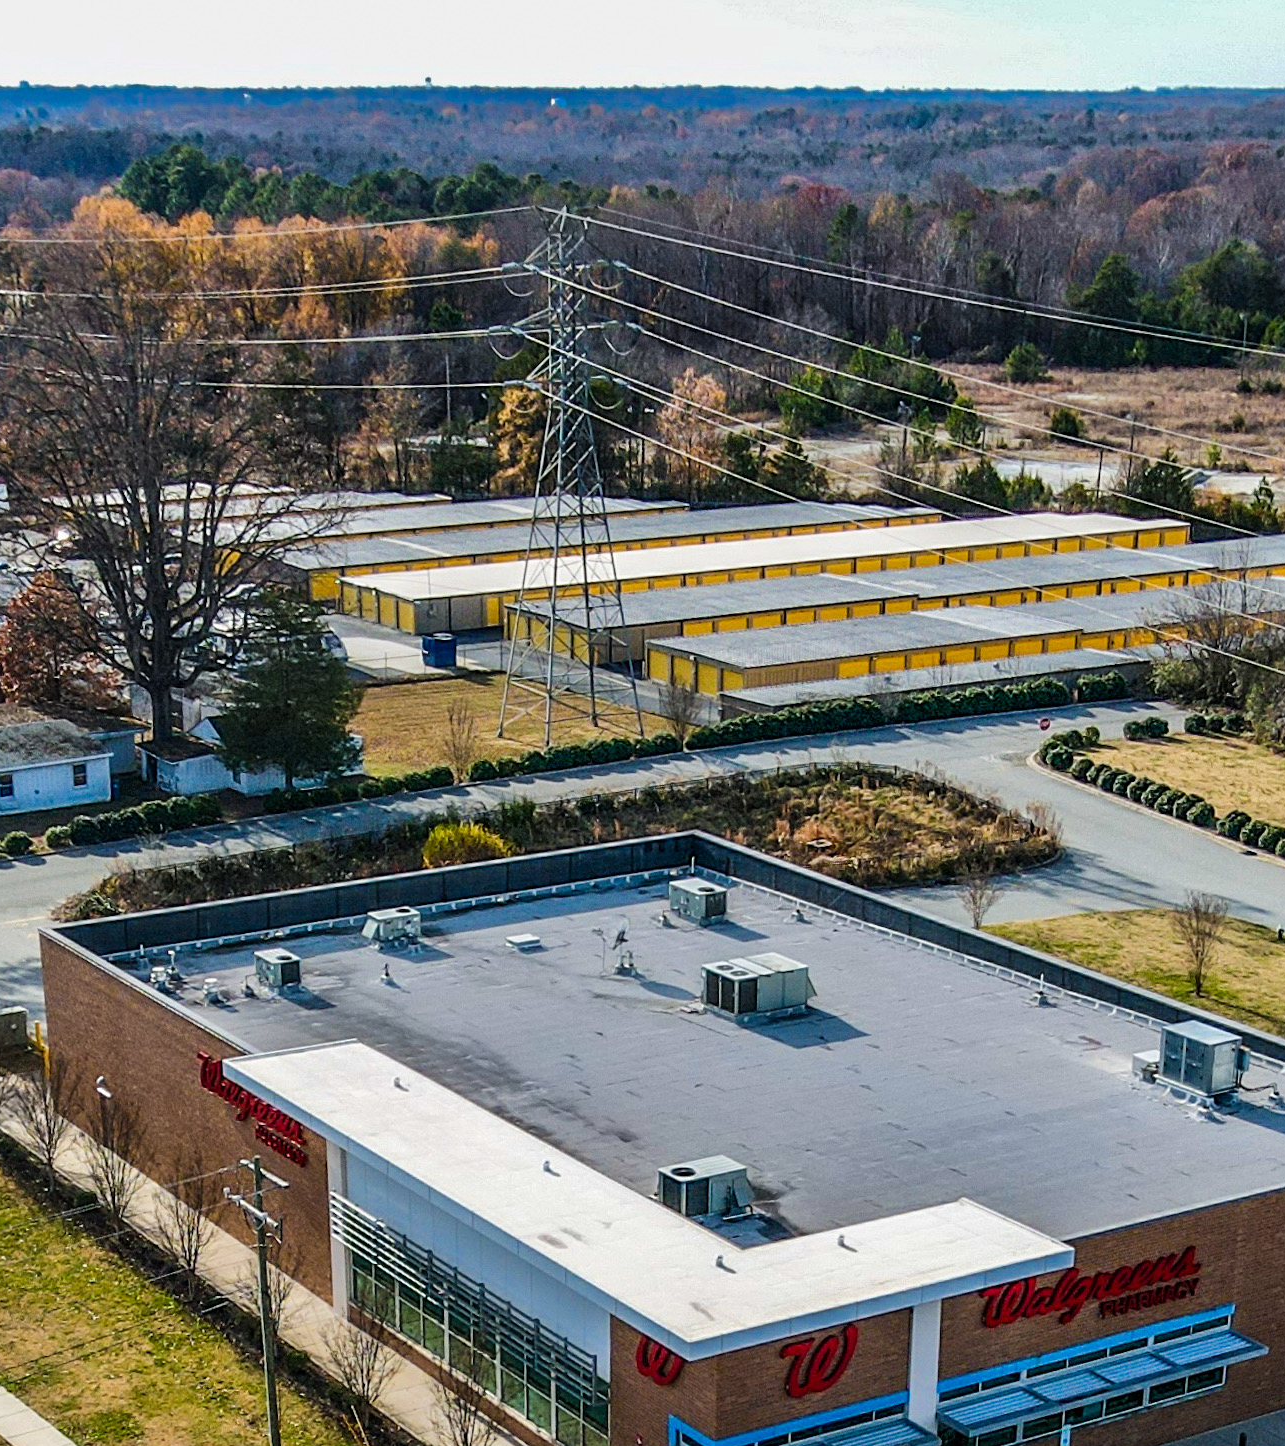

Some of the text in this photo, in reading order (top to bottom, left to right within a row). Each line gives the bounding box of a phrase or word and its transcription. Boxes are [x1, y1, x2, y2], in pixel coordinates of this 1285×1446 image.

[979, 1245, 1201, 1328] Walgreens
[1098, 1278, 1199, 1319] PHARMACY
[779, 1322, 858, 1399] W
